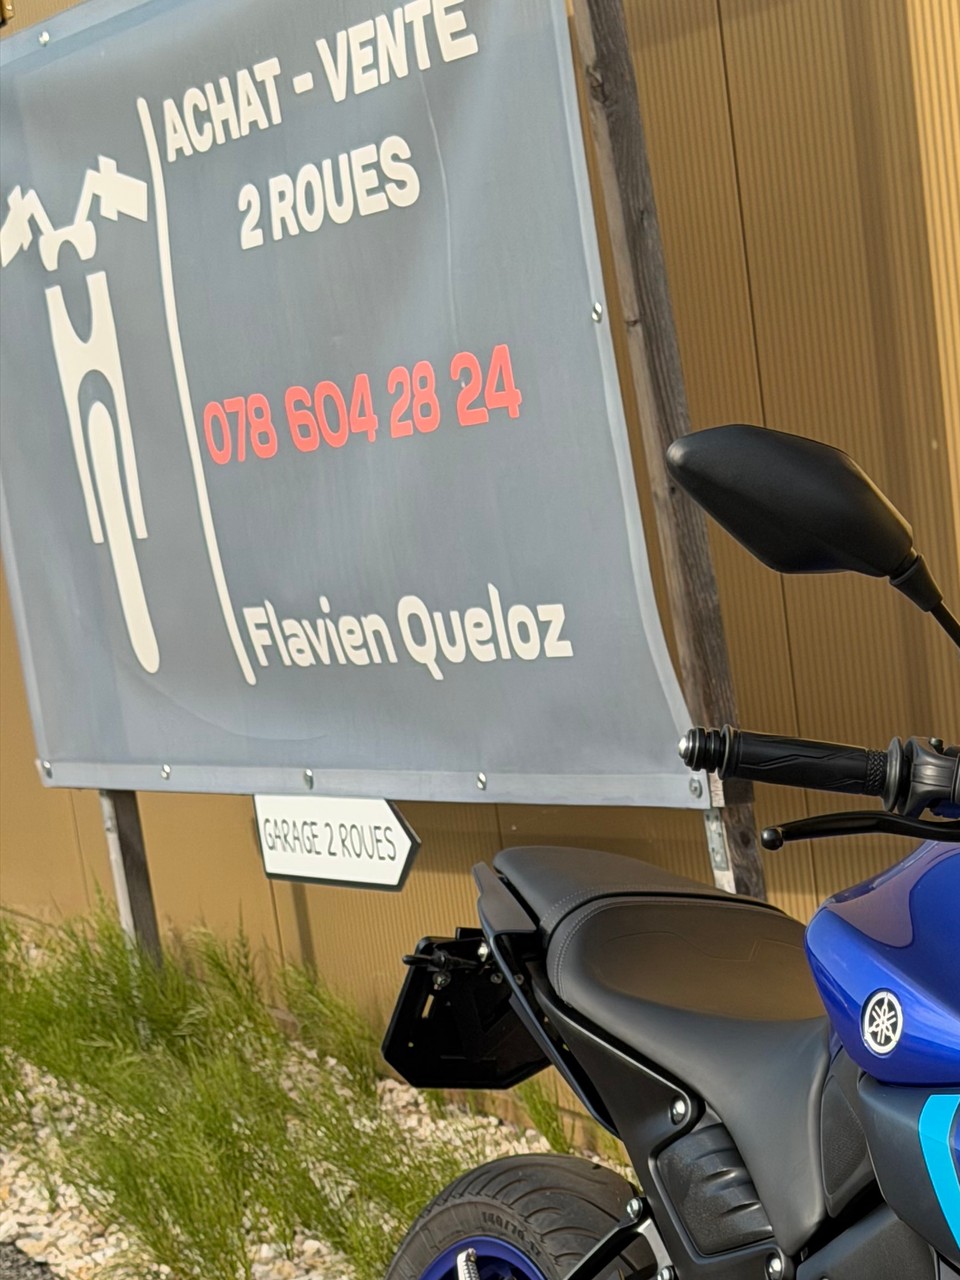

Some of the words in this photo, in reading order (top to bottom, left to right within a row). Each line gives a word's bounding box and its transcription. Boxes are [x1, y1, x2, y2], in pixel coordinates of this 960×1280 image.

[163, 57, 282, 162] ACHAT
[316, 0, 479, 102] VENTE
[238, 184, 264, 250] 2
[269, 136, 420, 240] ROUES
[203, 393, 278, 465] 078
[284, 374, 378, 452] 604
[388, 361, 440, 438] 28
[450, 344, 522, 427] 24
[242, 596, 398, 668] Flavien
[398, 583, 574, 681] Queloz
[264, 818, 322, 855] GARAGE
[324, 822, 337, 856] 2
[338, 823, 397, 861] ROUES
